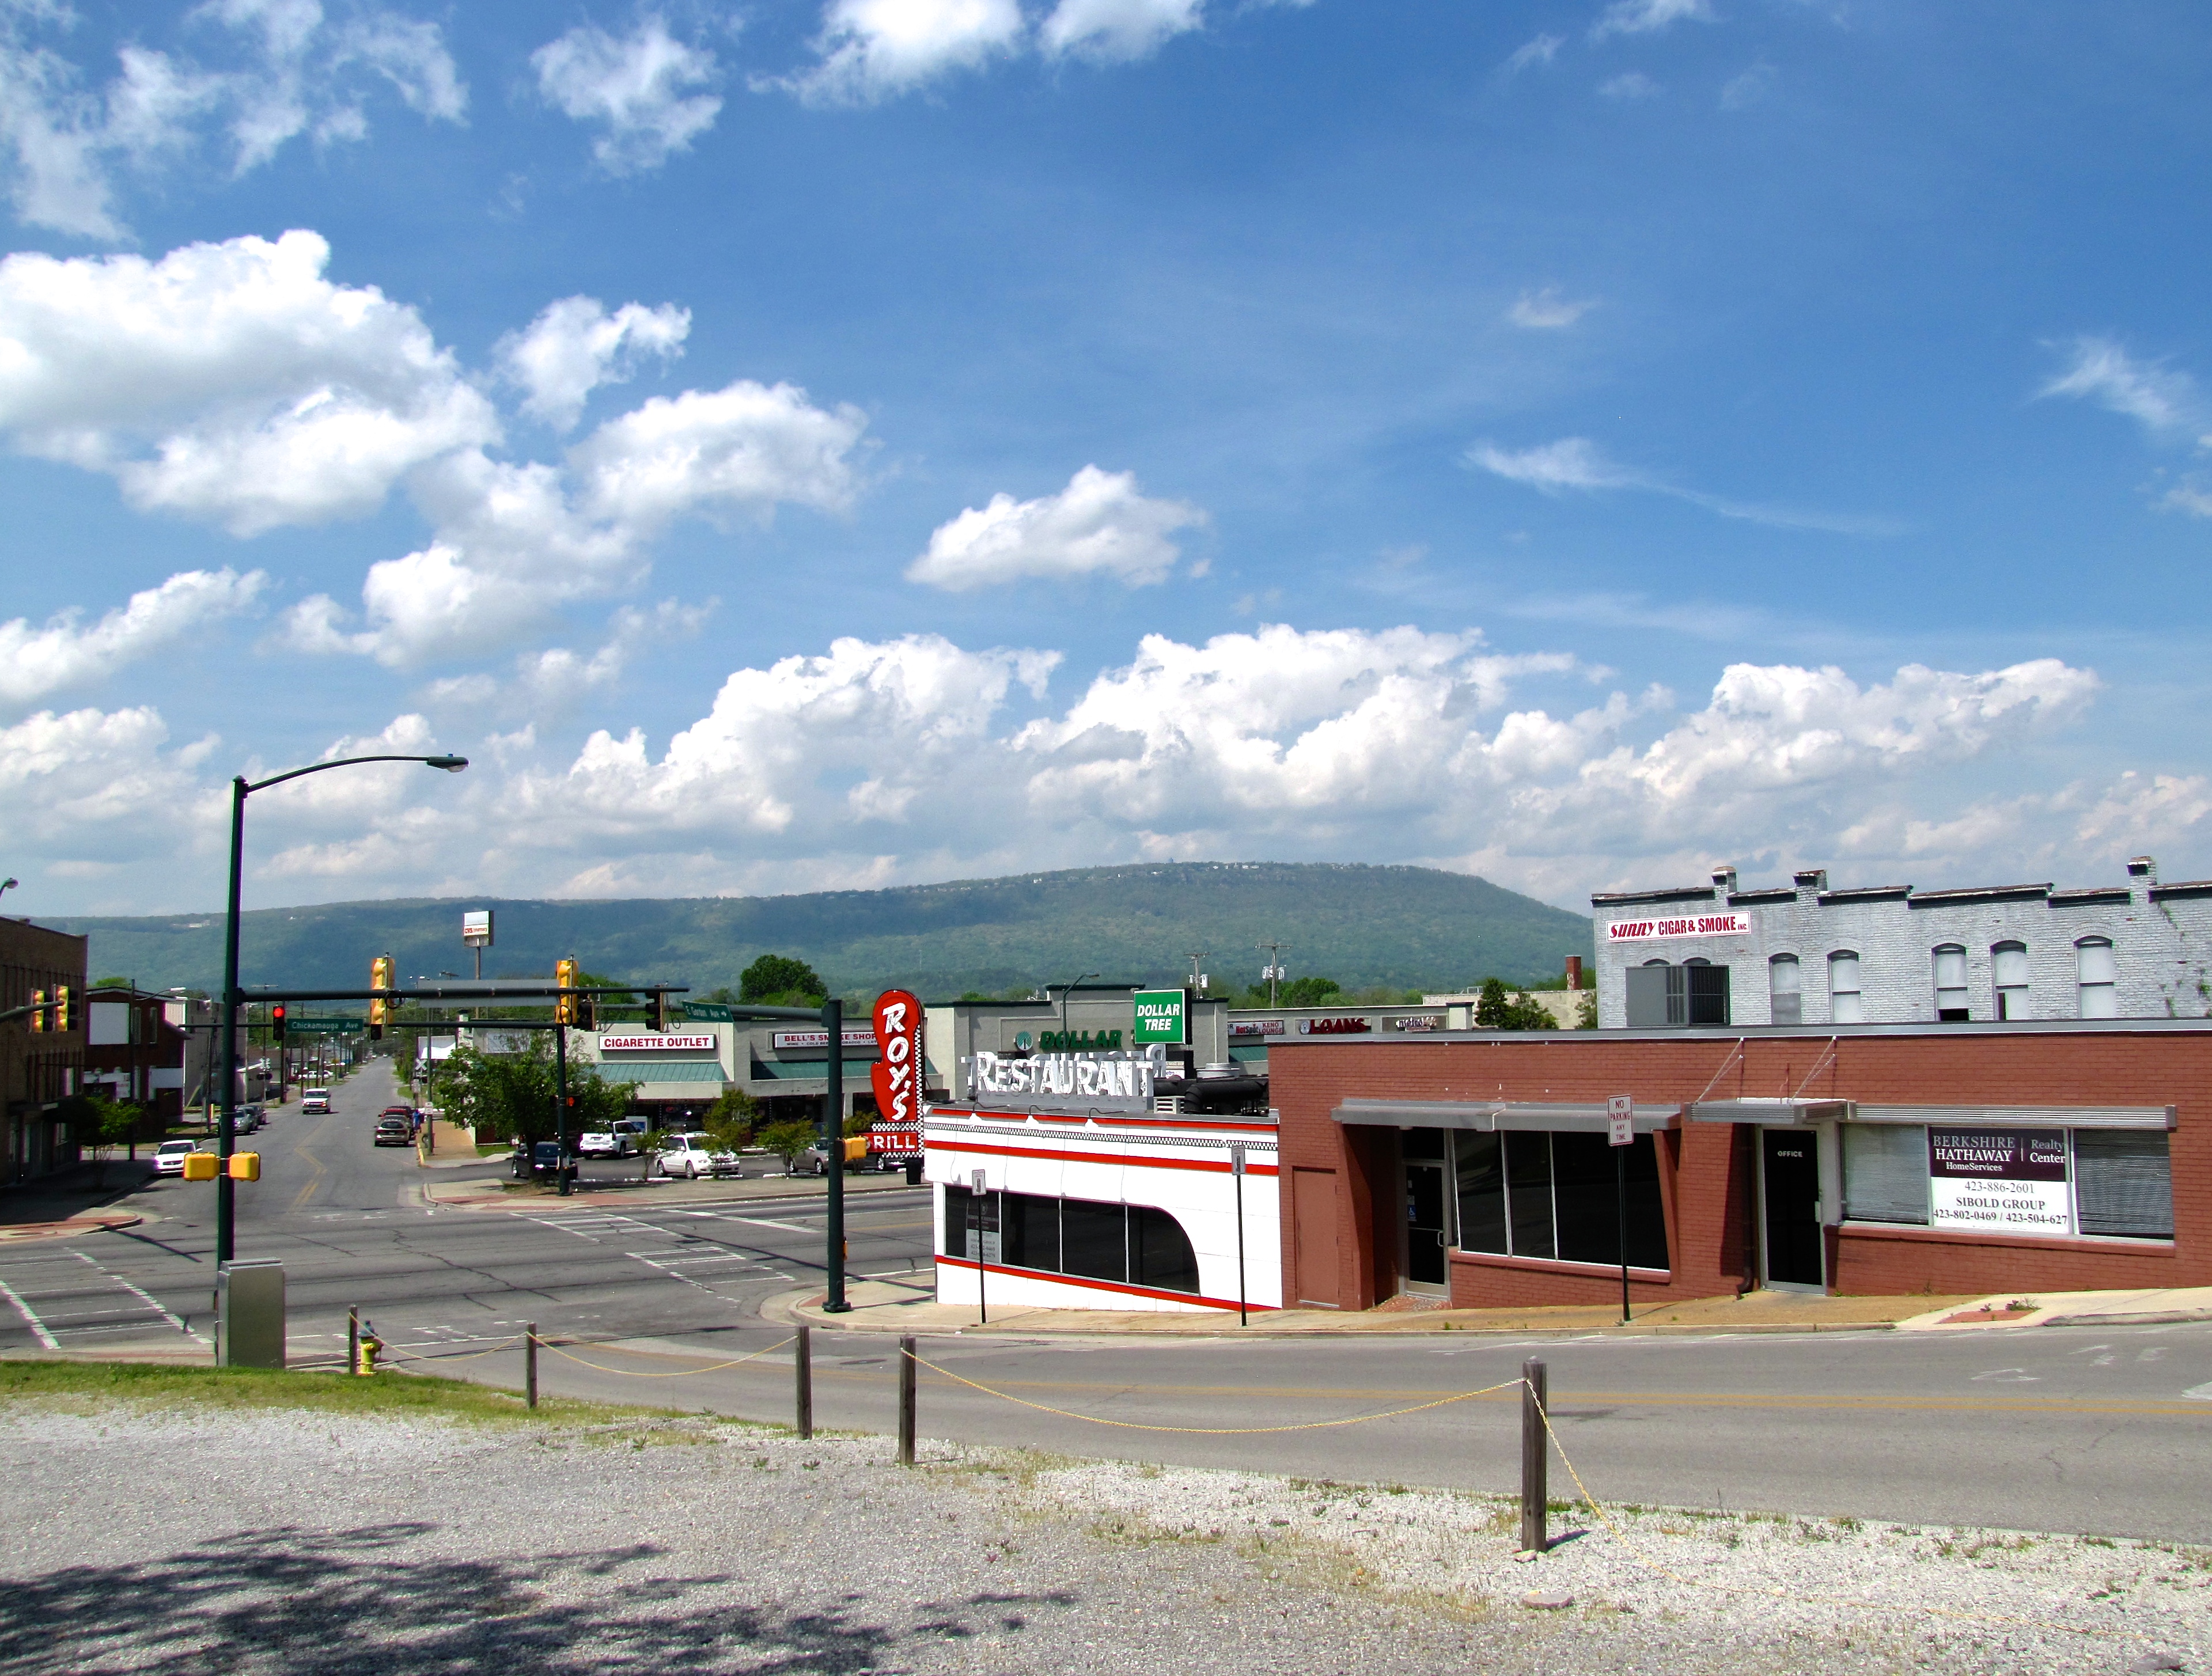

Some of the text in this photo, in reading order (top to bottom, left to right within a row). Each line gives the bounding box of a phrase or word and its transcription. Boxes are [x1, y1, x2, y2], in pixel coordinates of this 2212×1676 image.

[1658, 919, 1687, 935] CIGAR
[1698, 916, 1736, 932] SMOKE
[1137, 1004, 1180, 1017] DOLLAR
[291, 1021, 339, 1031] Chickamauga
[1144, 1018, 1172, 1031] TREE
[1236, 1025, 1259, 1034] HotSpot
[1310, 1018, 1368, 1034] LOANS
[605, 1038, 709, 1047] CIGARETTE OUTLET
[1040, 1030, 1123, 1049] DOLLAR
[977, 1052, 1153, 1097] RESTAURANT
[1615, 1100, 1624, 1109] NO
[1610, 1112, 1630, 1122] PARKING
[1933, 1135, 2015, 1148] BERKSHIRE
[2031, 1139, 2064, 1152] Realty
[1935, 1148, 2012, 1162] HATHAWAY
[2030, 1152, 2065, 1163] Center
[1946, 1162, 2003, 1171] HomeServices
[1965, 1181, 2035, 1193] 423-886-2601
[1956, 1197, 2046, 1210] SIBOLD GROUP
[1933, 1209, 1997, 1221] 423-802-0469
[2006, 1213, 2067, 1224] 423-504-627
